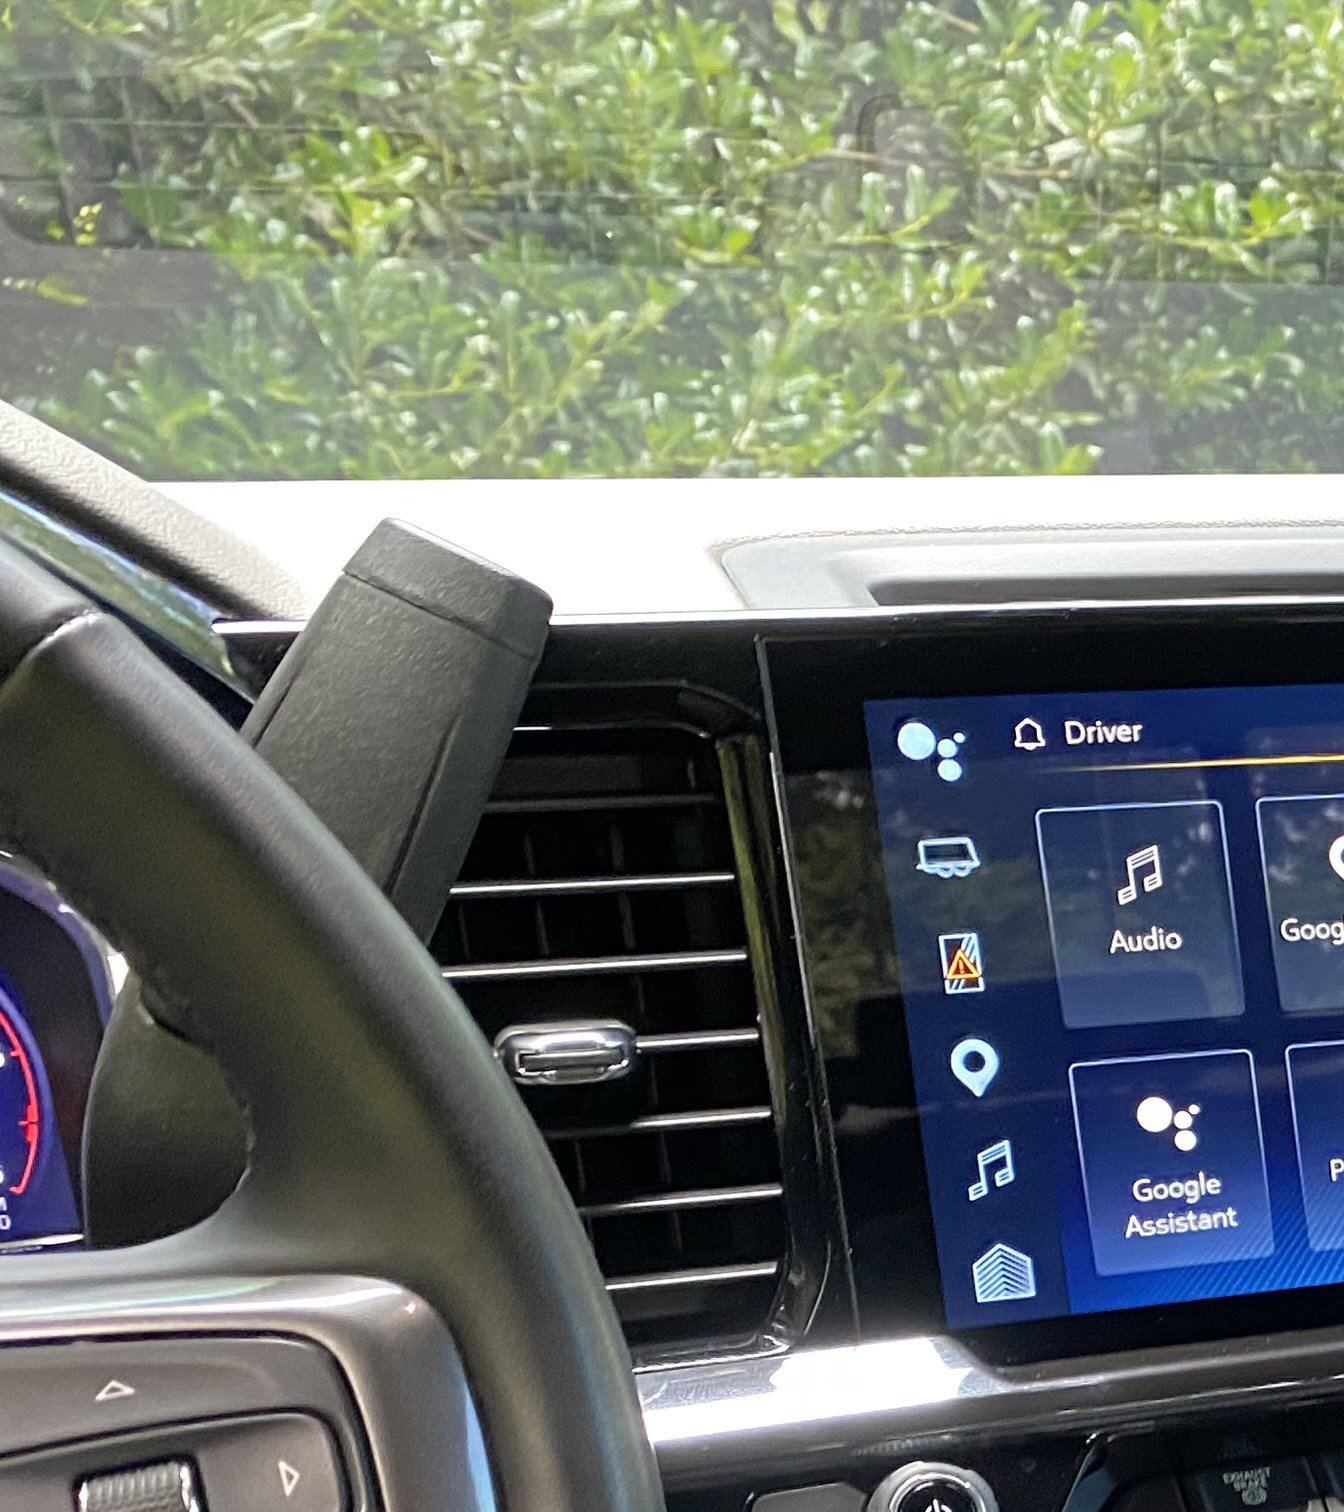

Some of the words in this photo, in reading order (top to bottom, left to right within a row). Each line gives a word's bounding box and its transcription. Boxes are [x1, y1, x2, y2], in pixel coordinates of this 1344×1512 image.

[1064, 720, 1143, 745] Driver
[1109, 926, 1182, 954] Audio
[1132, 1171, 1221, 1204] Google
[1125, 1206, 1238, 1239] Assistant
